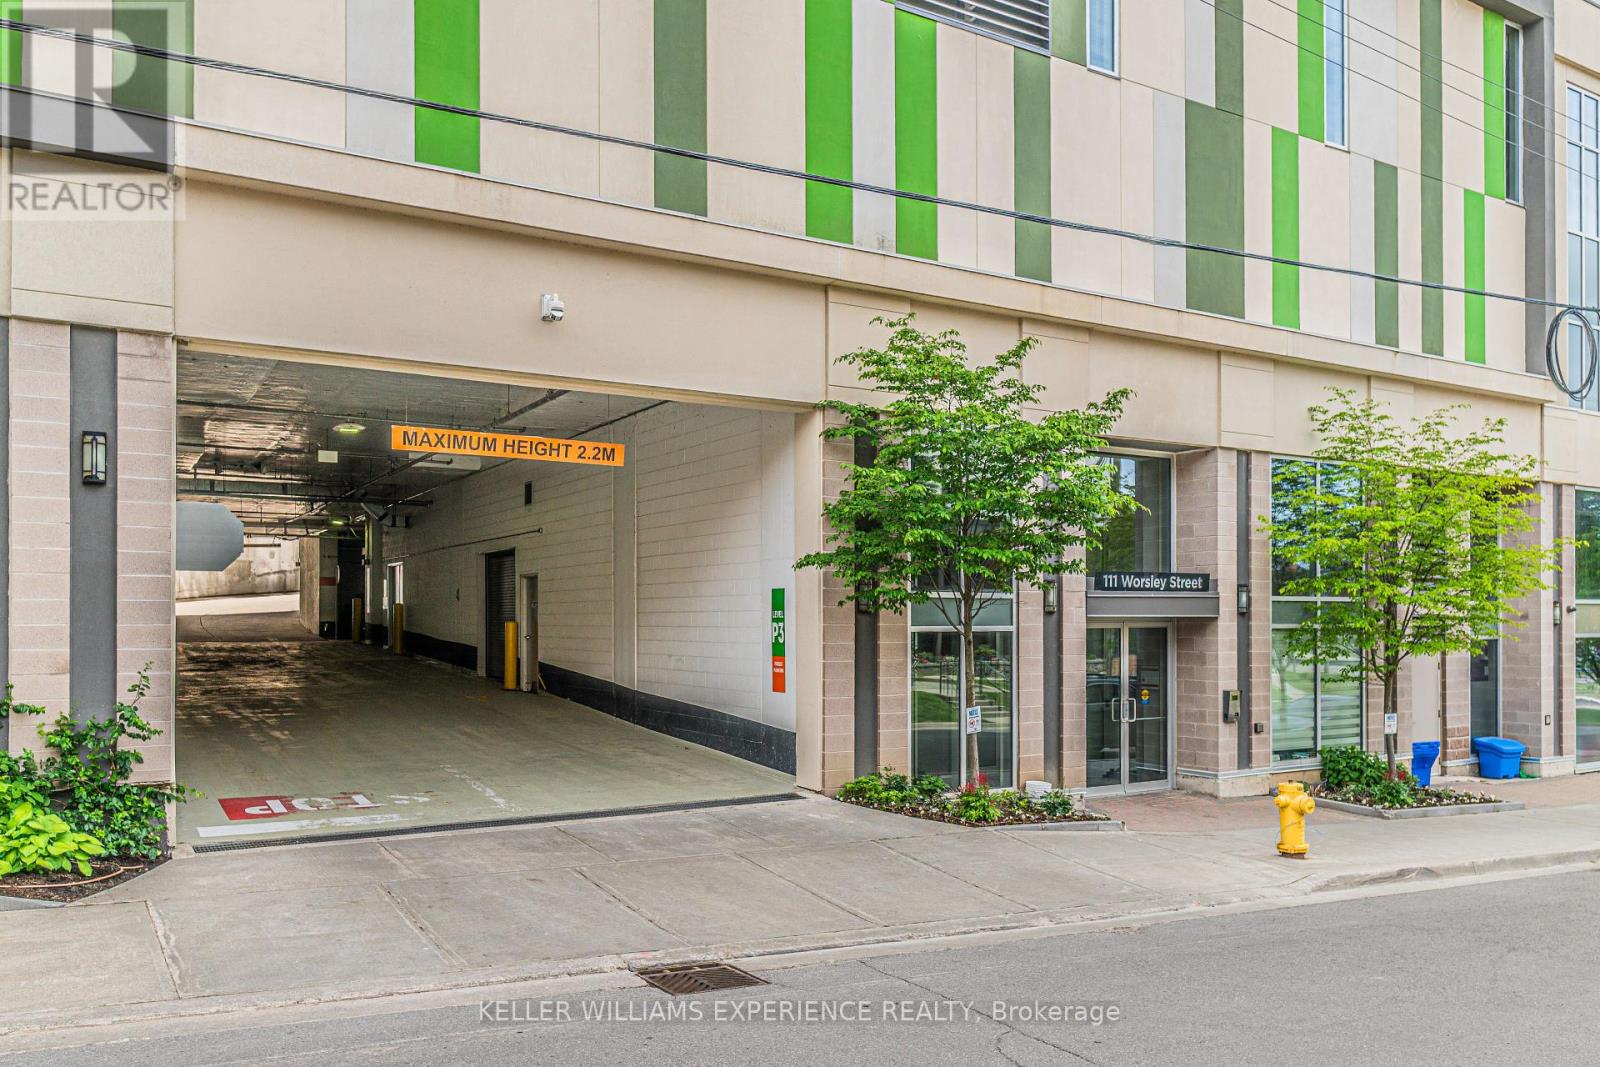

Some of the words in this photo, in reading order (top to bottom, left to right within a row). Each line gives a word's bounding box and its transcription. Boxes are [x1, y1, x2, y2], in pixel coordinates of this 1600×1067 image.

[402, 431, 497, 453] MAXIMUM
[503, 438, 573, 459] HEIGHT
[577, 445, 616, 462] 2.2M
[1103, 574, 1118, 588] 111
[1121, 574, 1167, 591] Worsley
[1169, 575, 1203, 589] Street
[772, 622, 785, 643] P3
